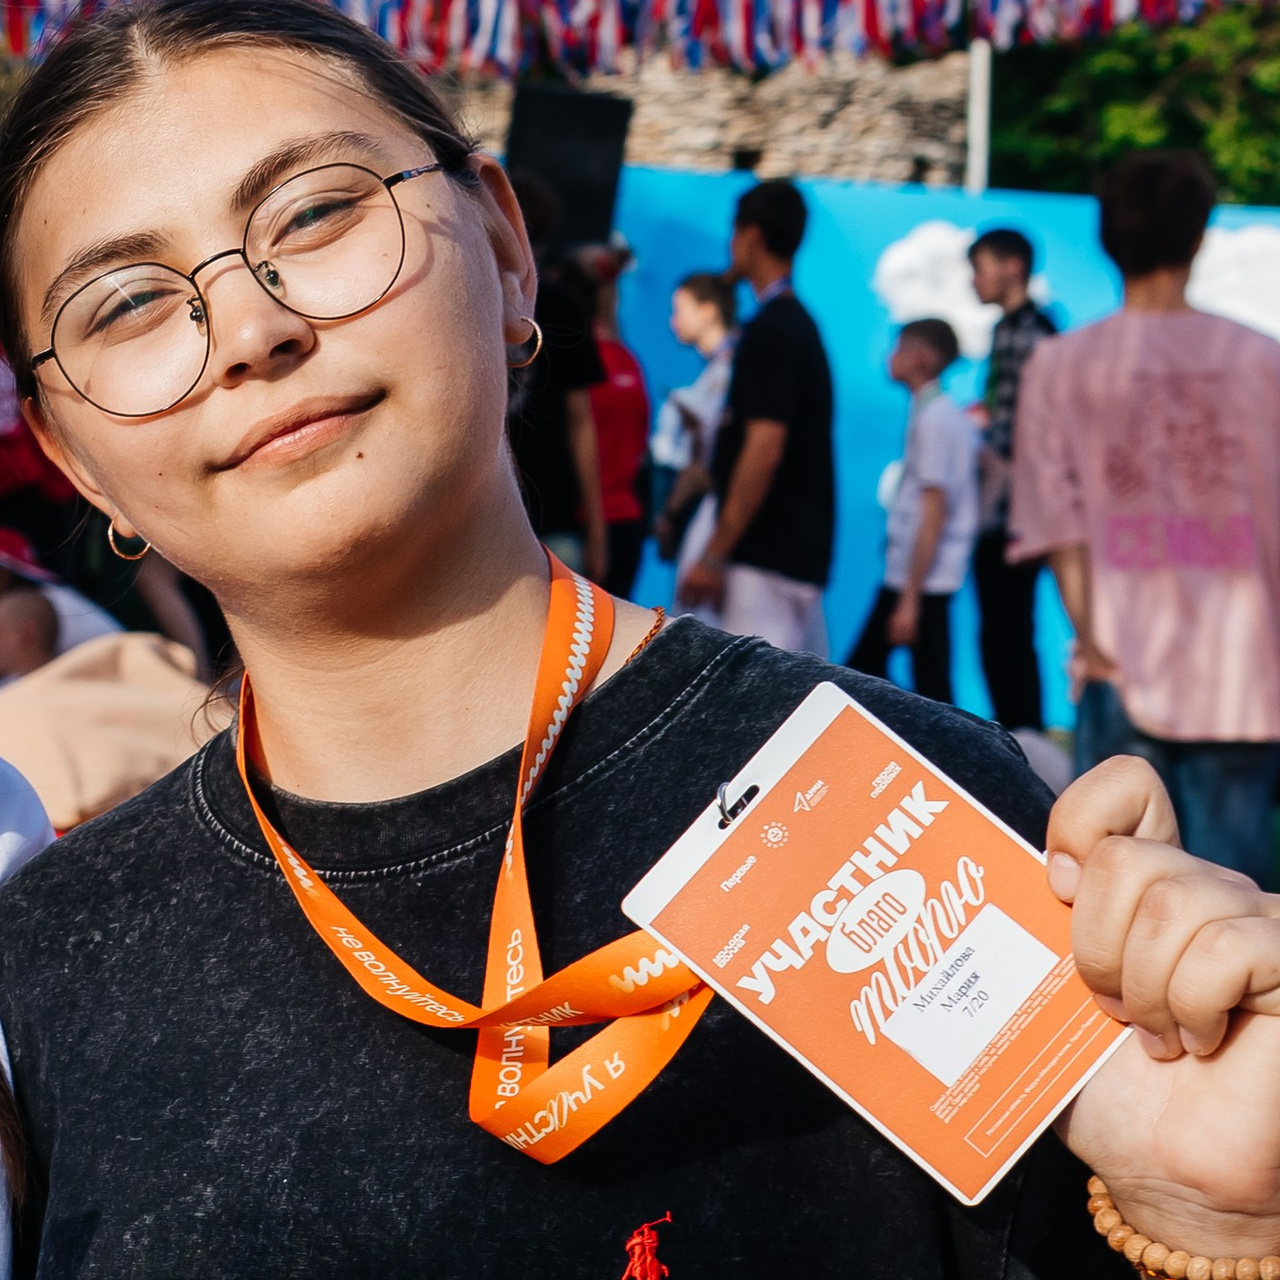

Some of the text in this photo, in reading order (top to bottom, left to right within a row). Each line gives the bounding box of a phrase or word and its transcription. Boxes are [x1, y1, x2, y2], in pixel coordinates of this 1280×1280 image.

[720, 854, 757, 893] Первые
[736, 780, 951, 1005] УЧАСТНИК
[842, 889, 908, 954] благо
[911, 944, 977, 1014] Михайлова
[940, 969, 981, 1015] Мария
[961, 989, 991, 1019] 7/20
